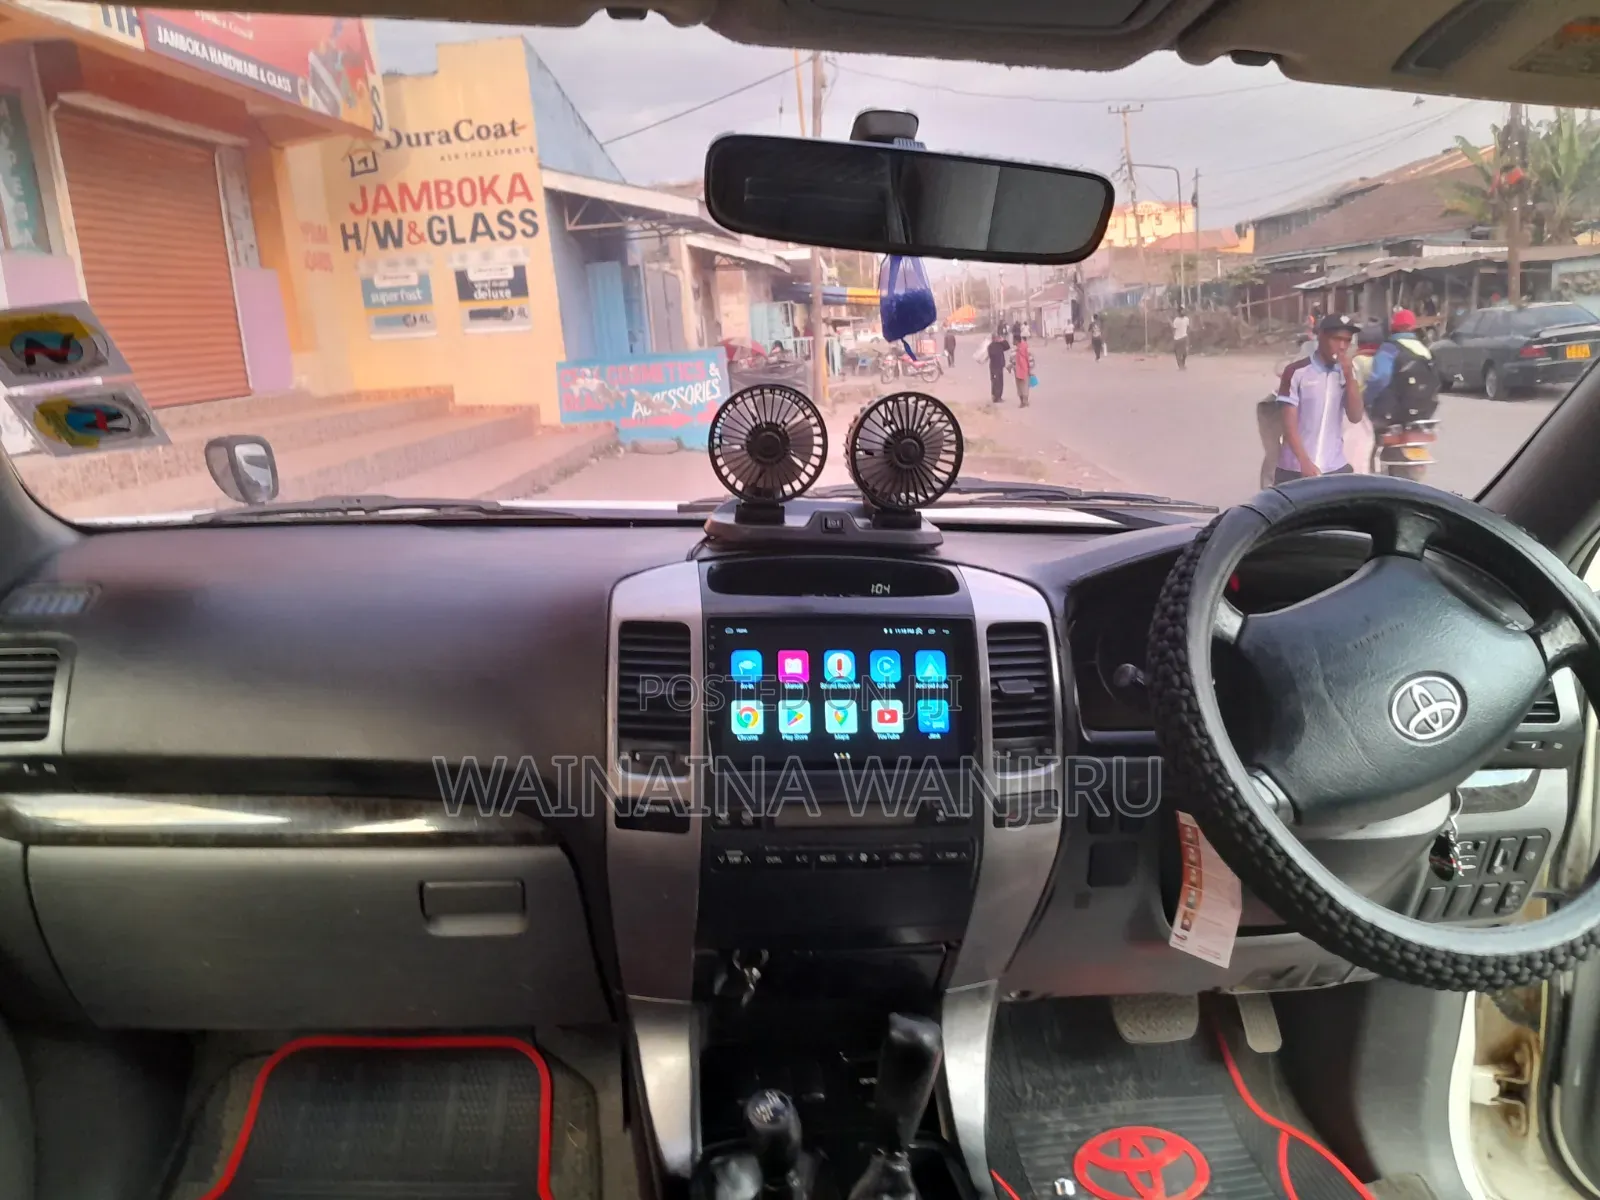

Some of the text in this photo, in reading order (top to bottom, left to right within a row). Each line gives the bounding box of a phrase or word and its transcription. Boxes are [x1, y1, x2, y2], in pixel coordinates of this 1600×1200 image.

[157, 25, 209, 61] JAMBOKA
[208, 45, 259, 80] HARDWARE
[266, 70, 292, 93] GLASS
[349, 172, 534, 216] JAMBOKA
[473, 288, 512, 300] deluxe
[606, 360, 706, 387] COSMETICS
[708, 362, 722, 380] &
